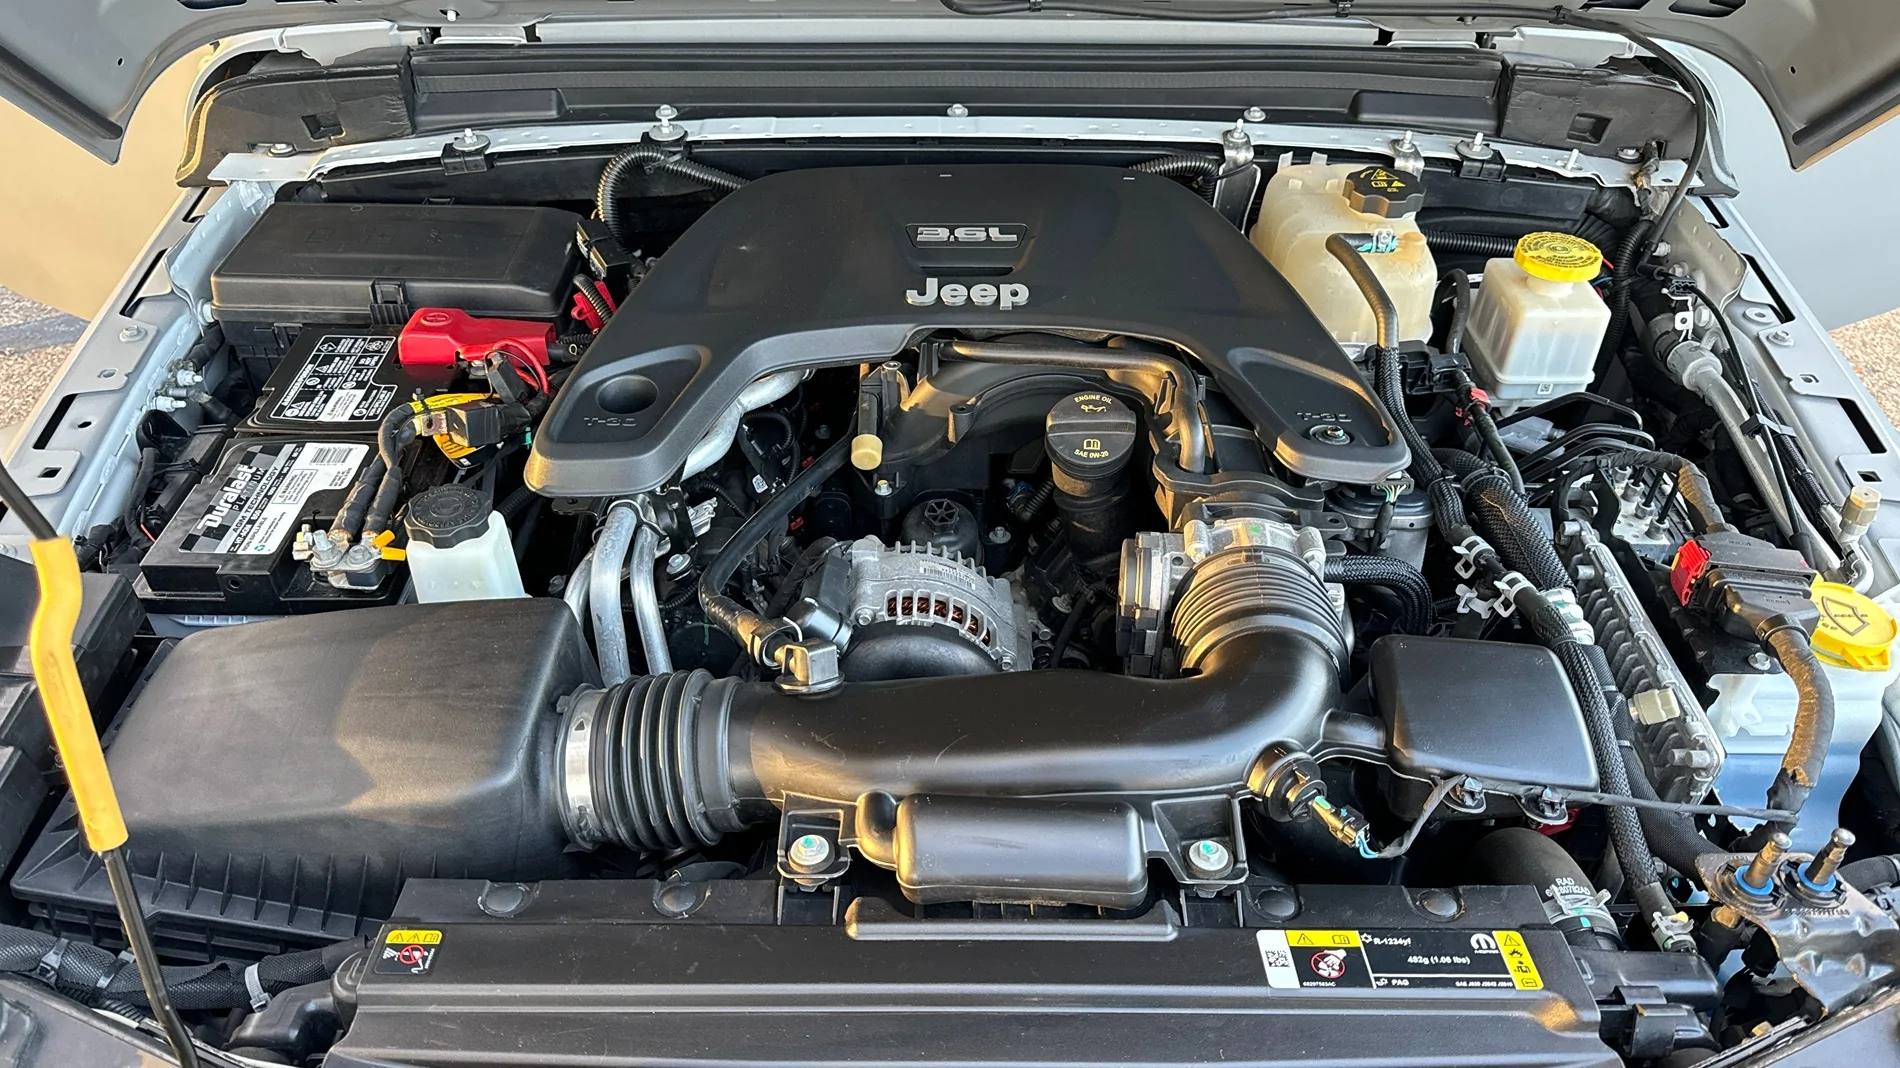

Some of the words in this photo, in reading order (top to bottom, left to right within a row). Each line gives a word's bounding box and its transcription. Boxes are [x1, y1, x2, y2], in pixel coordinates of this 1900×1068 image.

[917, 227, 1018, 241] 3.6L
[906, 277, 1029, 310] Jeep
[1074, 395, 1100, 403] ENGINE
[1101, 396, 1112, 404] OIL
[1074, 449, 1088, 458] SAE
[1089, 450, 1109, 458] 0W-20
[232, 467, 266, 511] PLATINUM
[196, 464, 257, 529] Duralast
[232, 515, 248, 533] AGM
[244, 466, 280, 514] TECHNOLOGY
[1555, 877, 1575, 886] RAD
[1373, 937, 1411, 947] R-1234yf
[1407, 956, 1430, 965] 482g
